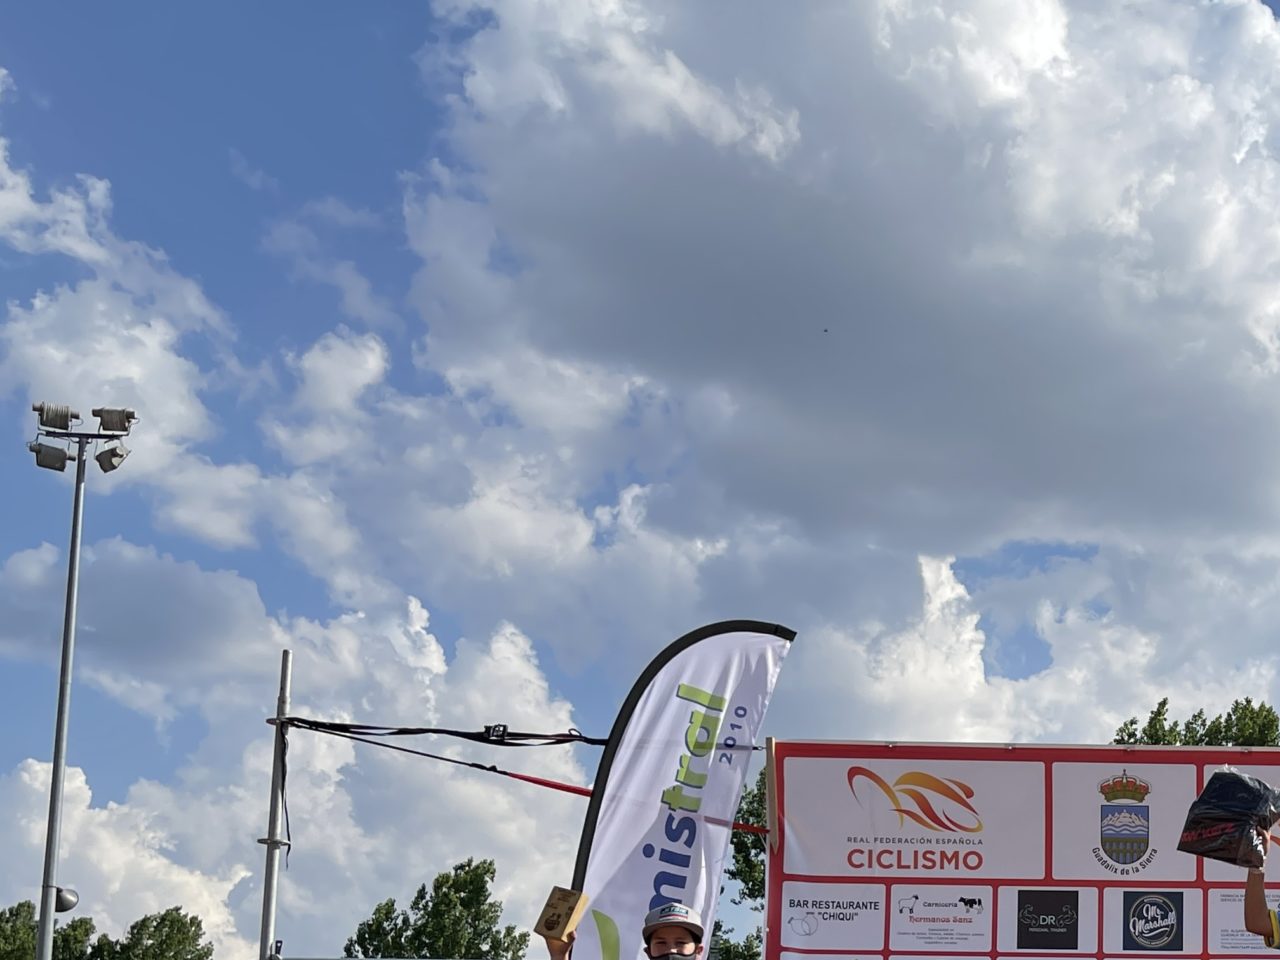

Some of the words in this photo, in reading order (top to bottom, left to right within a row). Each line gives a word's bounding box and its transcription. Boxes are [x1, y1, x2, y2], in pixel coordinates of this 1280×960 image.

[719, 706, 747, 766] 2010
[847, 836, 870, 844] REAL
[874, 836, 932, 844] FEDERACIÓN
[936, 836, 983, 845] ESPAÑOLA
[847, 848, 983, 870] CICLISMO
[1092, 847, 1117, 874] Guadalix
[1132, 866, 1140, 874] la
[1139, 848, 1158, 869] Sierra
[789, 899, 809, 909] BAR
[812, 900, 880, 911] RESTAURANTE
[818, 912, 859, 921] "CHIQUI"
[1039, 916, 1056, 925] DR
[1130, 911, 1176, 936] Marshall
